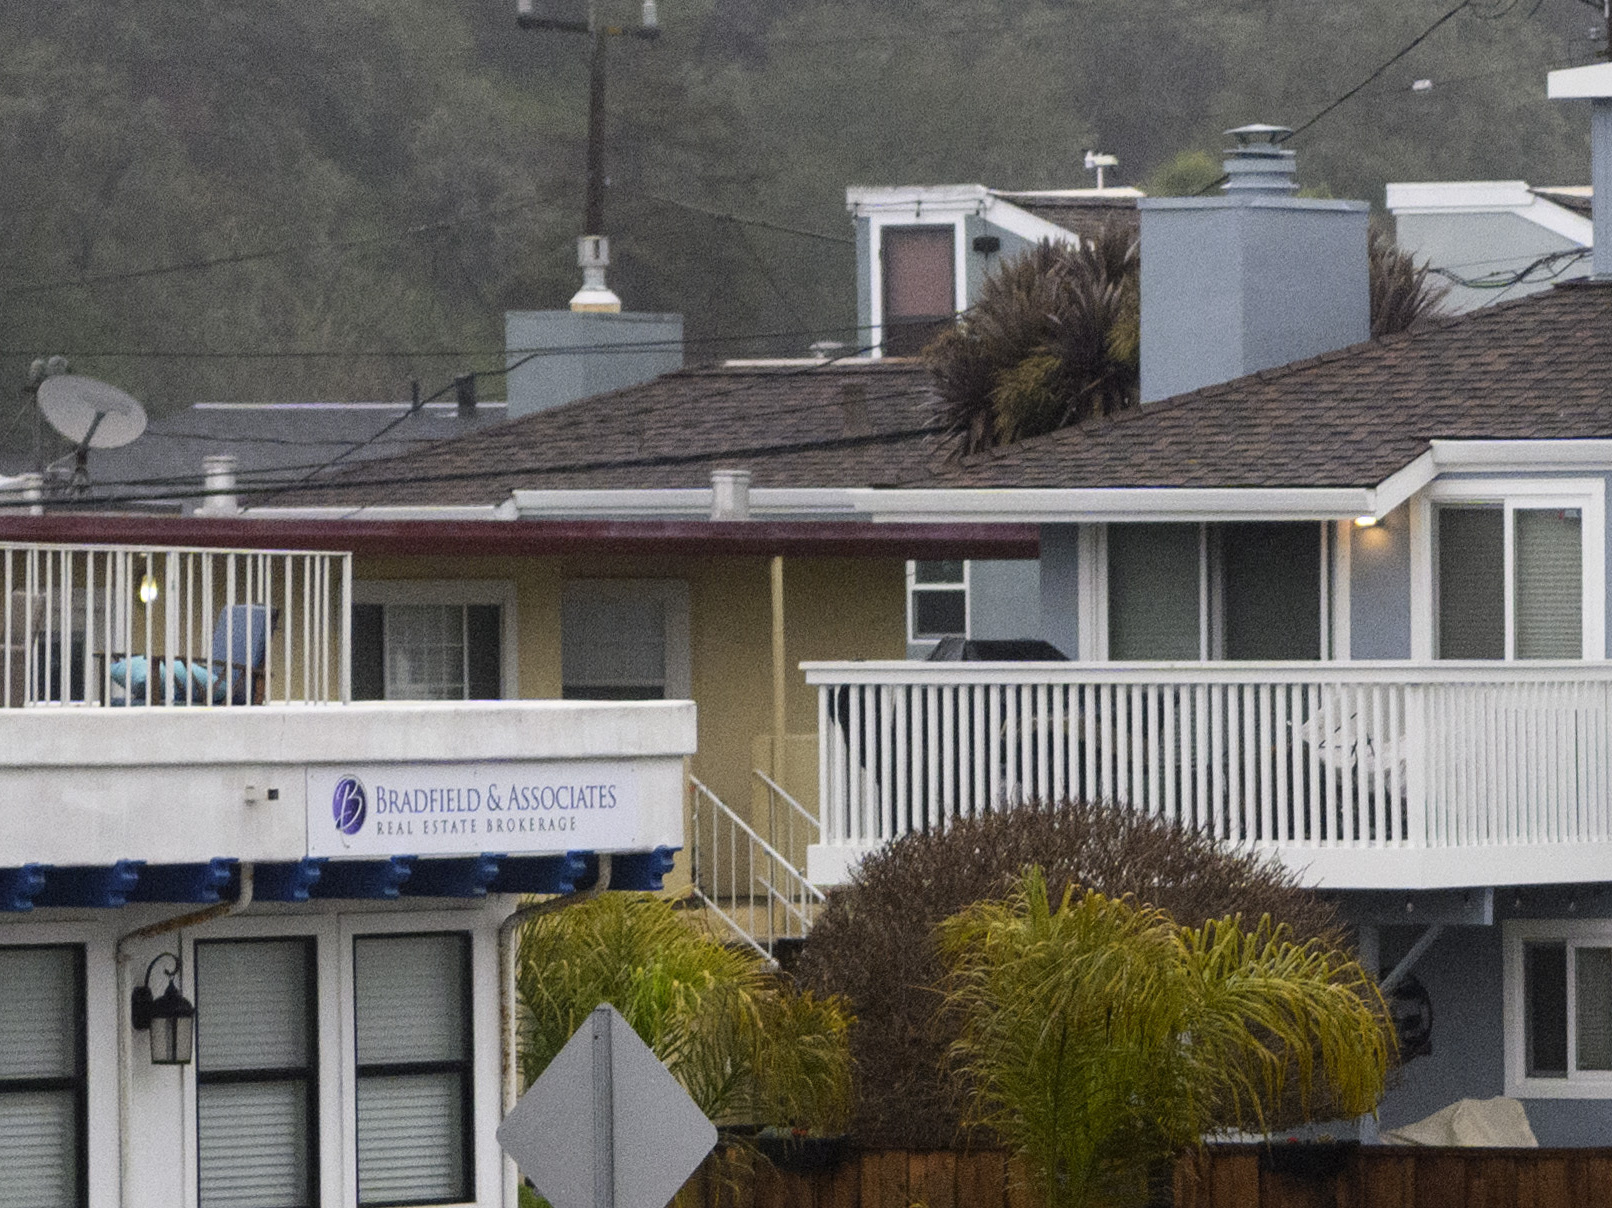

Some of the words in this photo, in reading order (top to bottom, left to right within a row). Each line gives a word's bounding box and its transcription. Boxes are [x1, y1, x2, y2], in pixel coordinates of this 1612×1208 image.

[376, 785, 481, 814] BRADFIELD
[486, 783, 503, 811] &
[507, 784, 617, 811] ASSOCIATES
[377, 820, 413, 835] REAL
[423, 819, 476, 835] ESTATE
[486, 816, 577, 833] BROKERAGE
